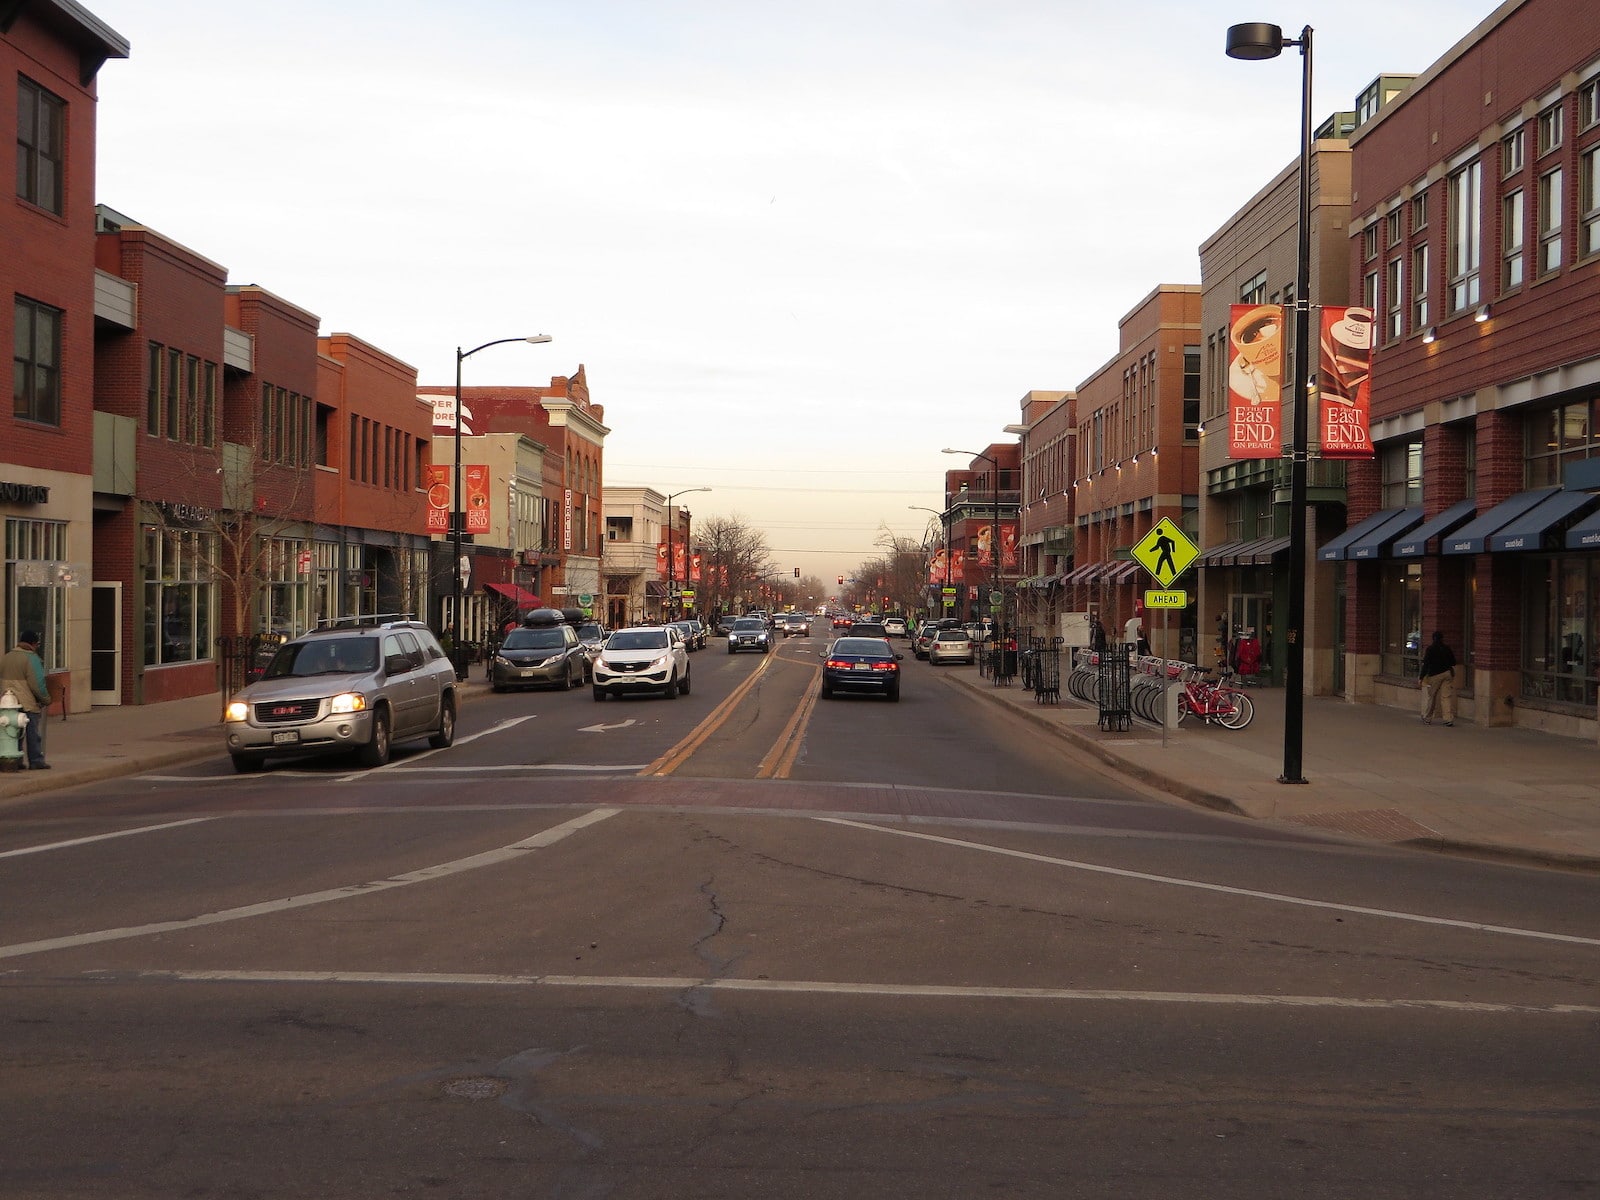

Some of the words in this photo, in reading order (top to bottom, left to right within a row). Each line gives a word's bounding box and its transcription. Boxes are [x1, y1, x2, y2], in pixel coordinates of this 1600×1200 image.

[1233, 424, 1275, 442] END
[1326, 425, 1366, 442] END
[429, 517, 447, 526] END
[468, 517, 488, 526] END
[1153, 595, 1179, 604] AHEAD
[272, 705, 302, 715] GMC
